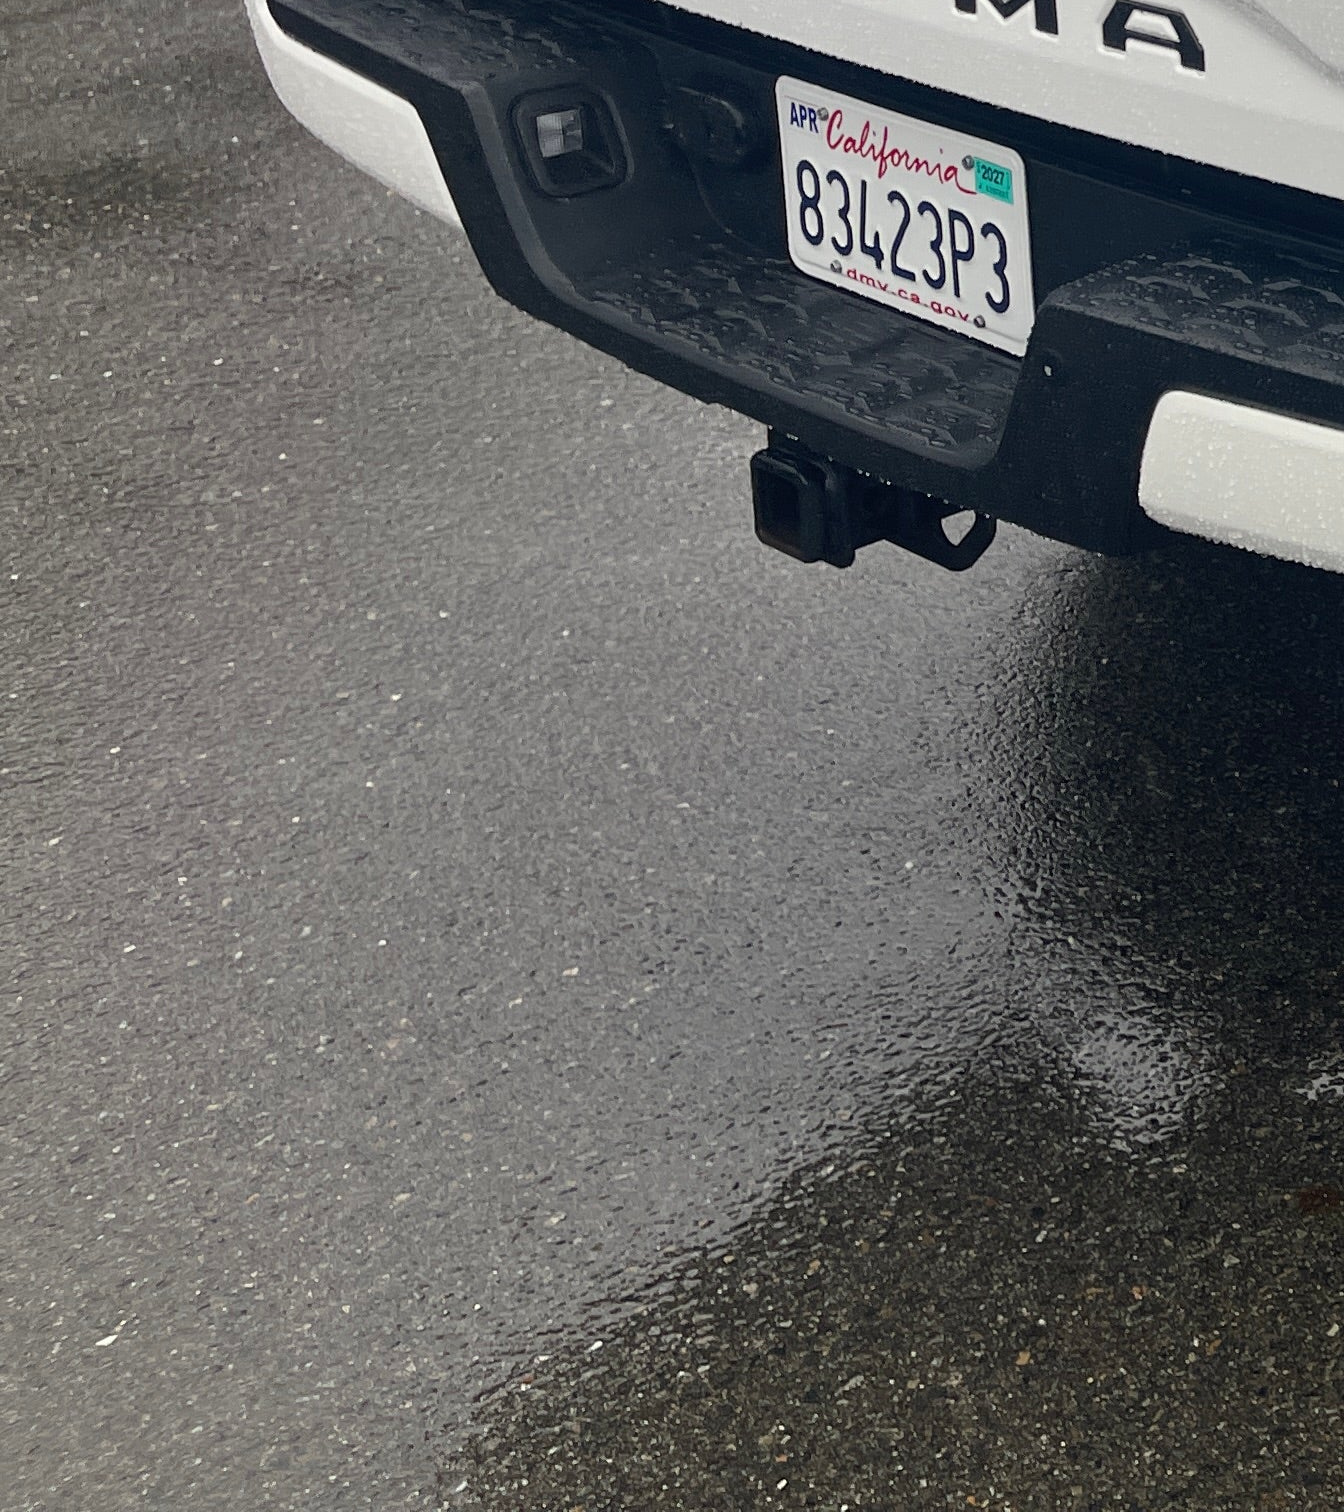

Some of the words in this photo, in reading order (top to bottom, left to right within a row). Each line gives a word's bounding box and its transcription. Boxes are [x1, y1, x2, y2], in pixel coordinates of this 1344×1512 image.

[790, 101, 820, 134] APR
[826, 109, 977, 195] California
[980, 164, 1005, 186] 2027
[796, 159, 1011, 314] 83423P3
[846, 268, 970, 322] dmv.ca.gov
